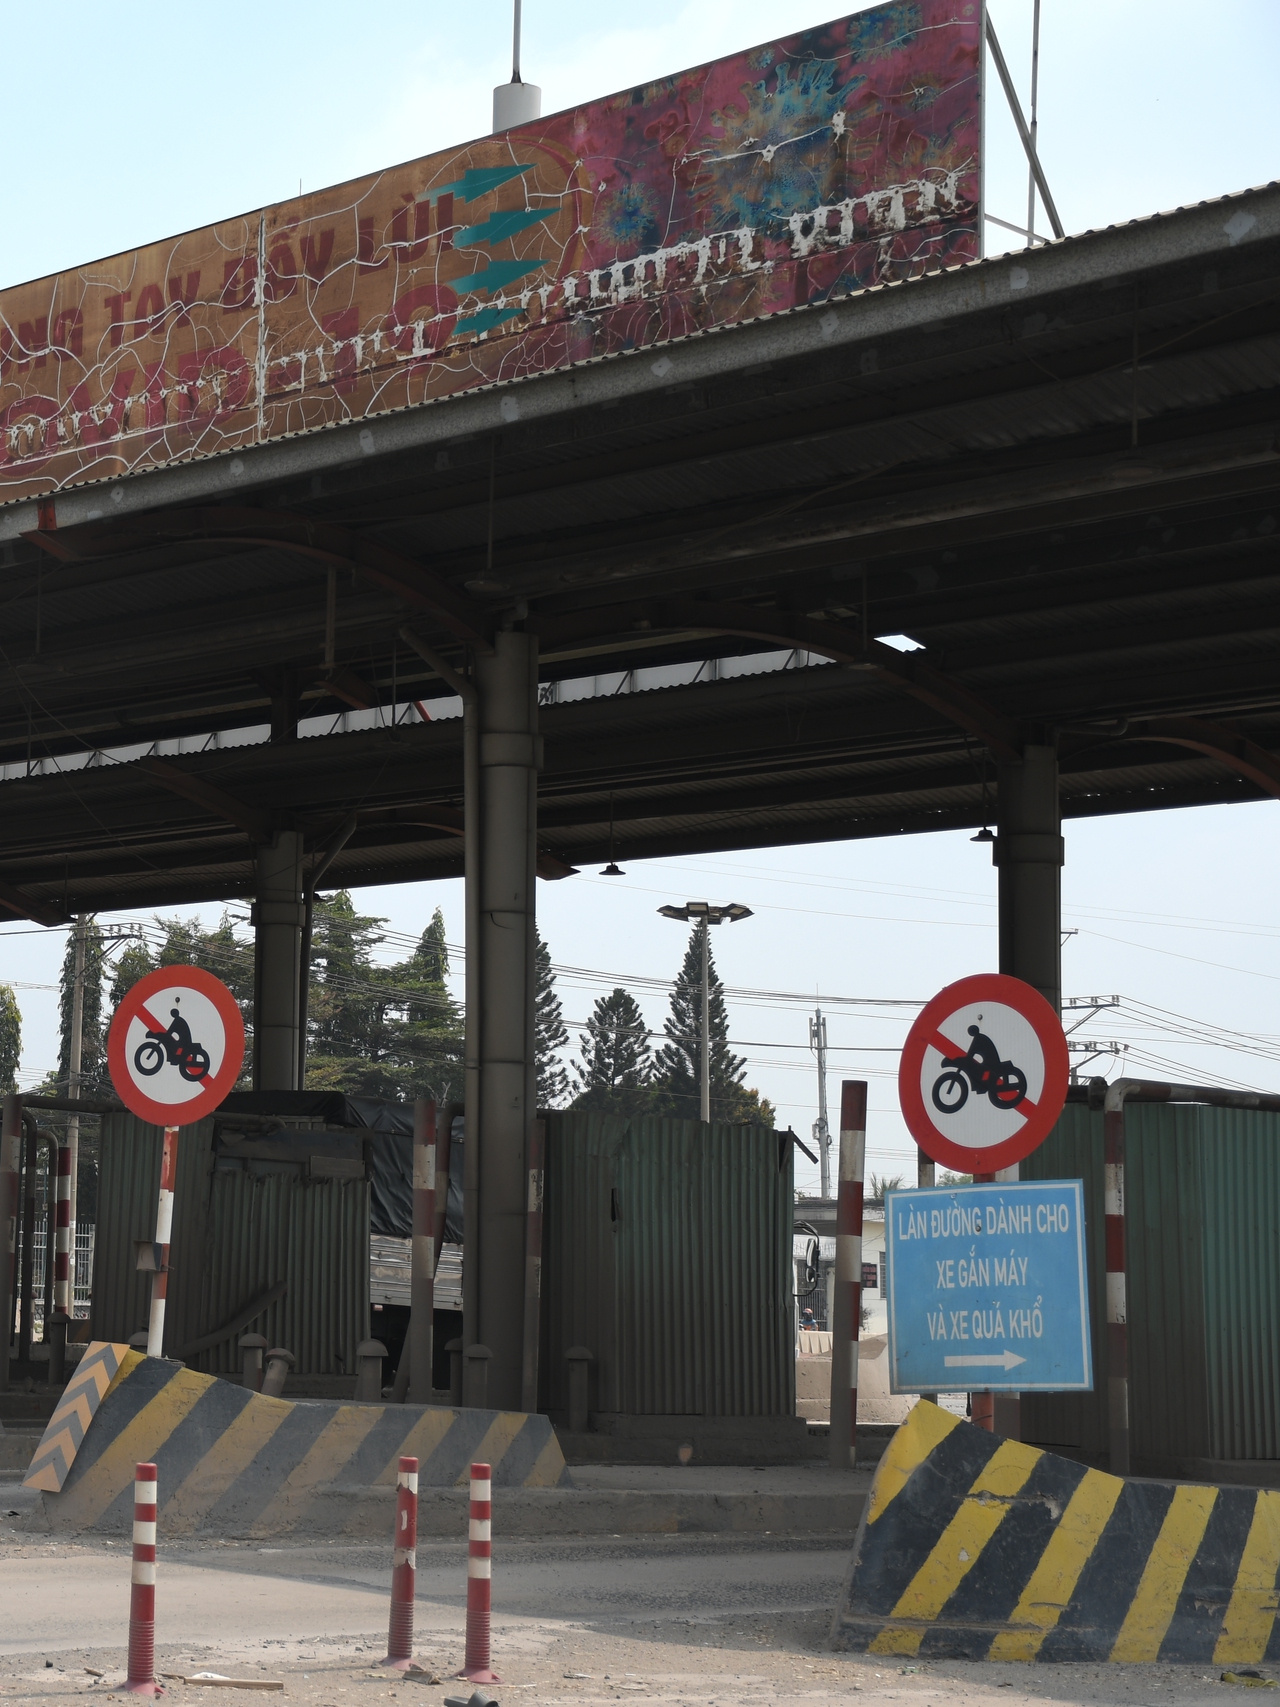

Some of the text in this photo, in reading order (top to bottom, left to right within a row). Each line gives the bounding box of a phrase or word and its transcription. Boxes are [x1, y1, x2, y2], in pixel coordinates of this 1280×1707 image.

[104, 269, 201, 349] TAY
[358, 191, 454, 277] LÙI
[898, 1197, 1069, 1240] LÀN ĐƯỜNG DÀNH CHO
[936, 1245, 1028, 1289] XE GẮN MÁY
[927, 1295, 1043, 1341] VÀ XE QUÁ KHỔ
